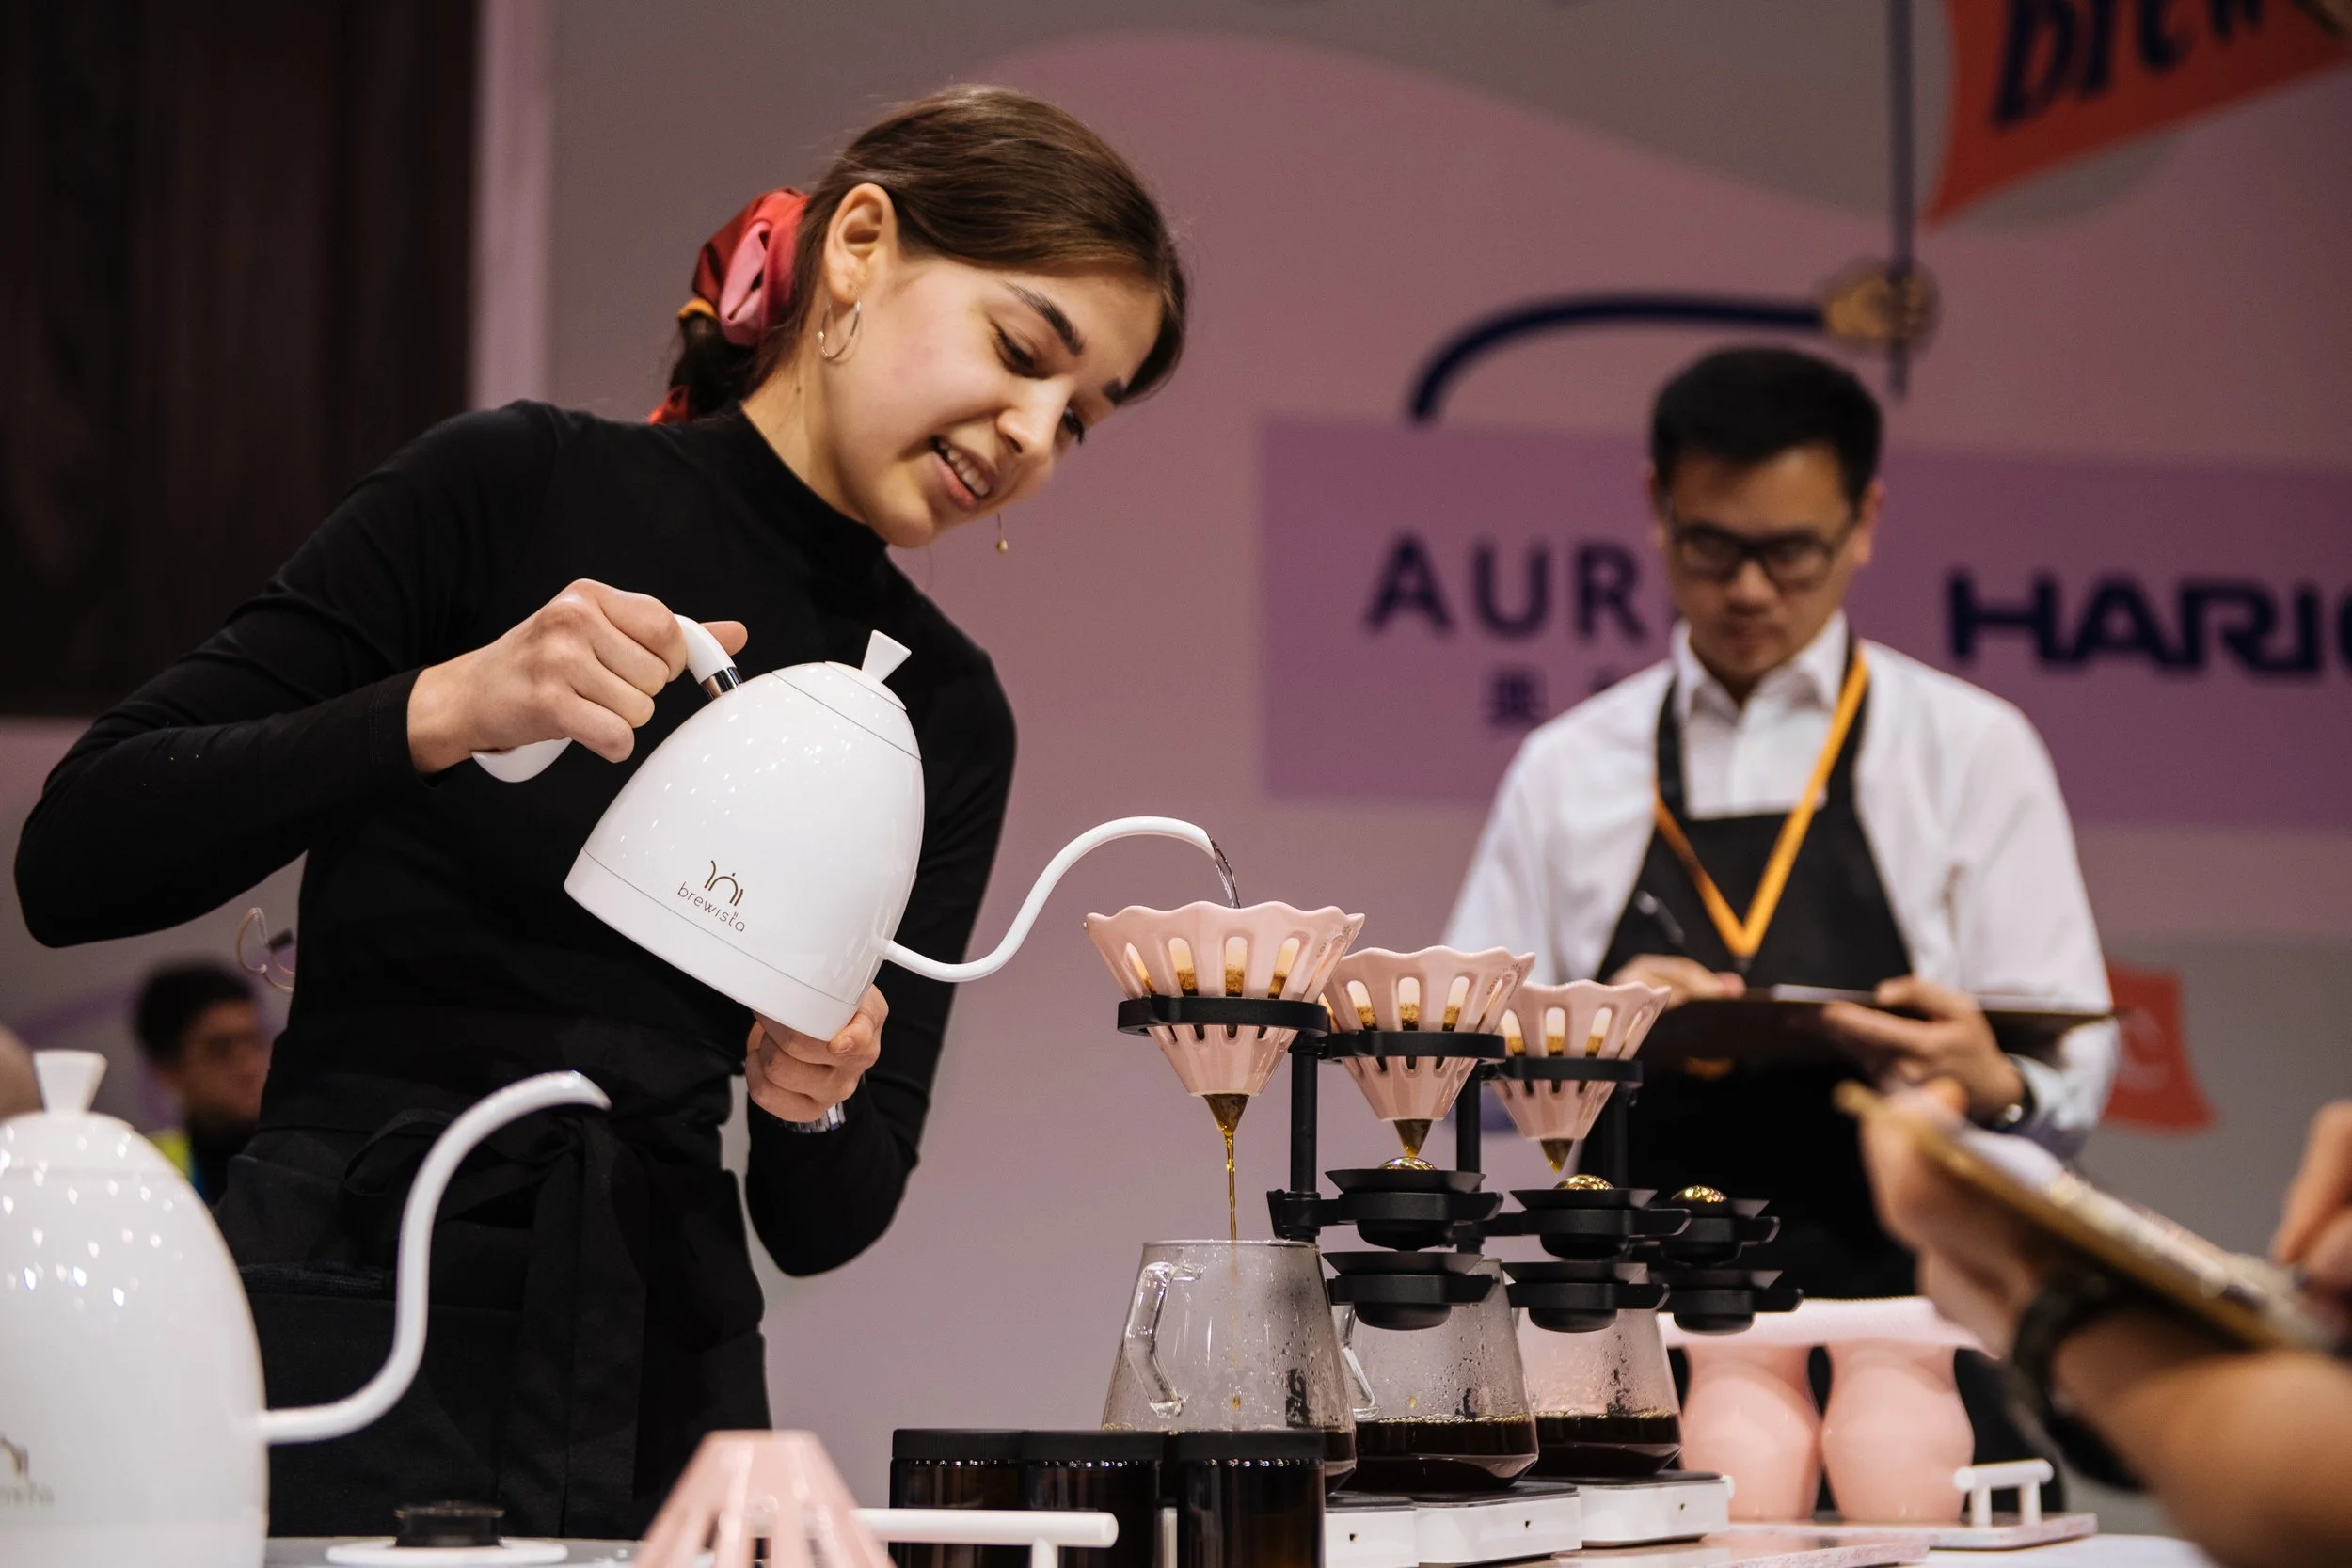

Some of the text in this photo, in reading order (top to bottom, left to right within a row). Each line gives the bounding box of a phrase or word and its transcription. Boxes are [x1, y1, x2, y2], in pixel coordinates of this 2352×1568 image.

[1364, 531, 1650, 643] AUR
[1947, 568, 2352, 679] HARI
[677, 881, 745, 932] brewista
